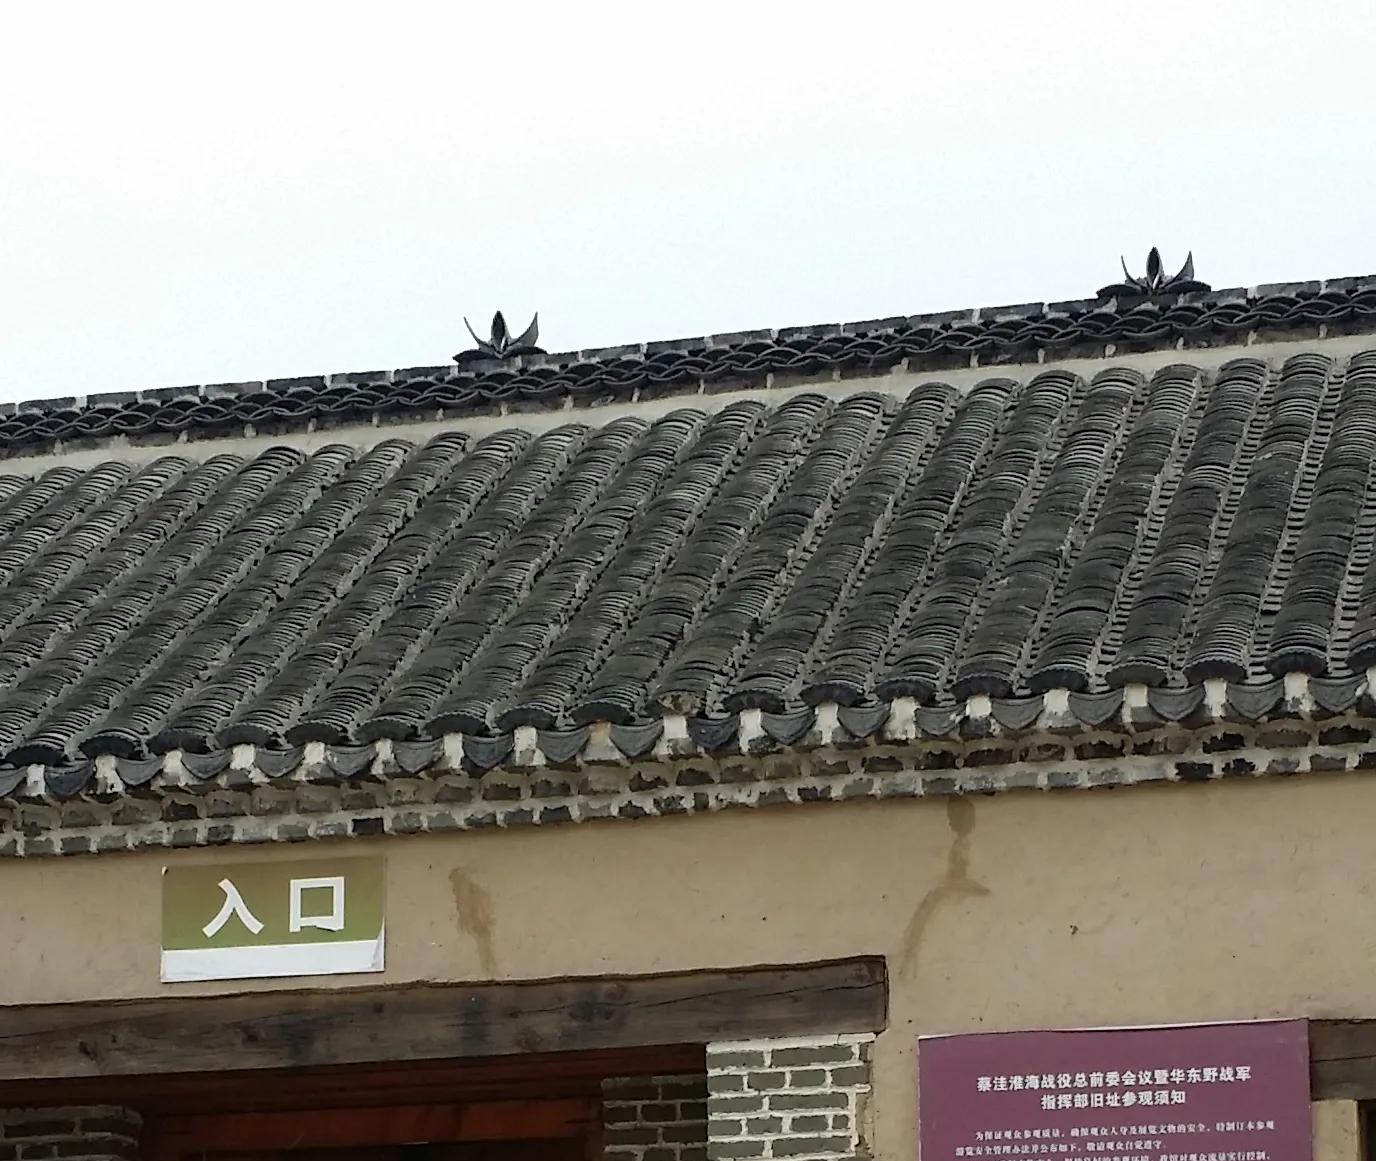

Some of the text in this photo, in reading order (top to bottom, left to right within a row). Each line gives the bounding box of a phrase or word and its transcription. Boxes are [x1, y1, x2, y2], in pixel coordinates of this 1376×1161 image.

[202, 876, 345, 938] 入口
[976, 1065, 1251, 1091] 蔡洼淮海战役总前委会议暨华东野战军
[1040, 1089, 1186, 1110] 指挥部旧址参观须知
